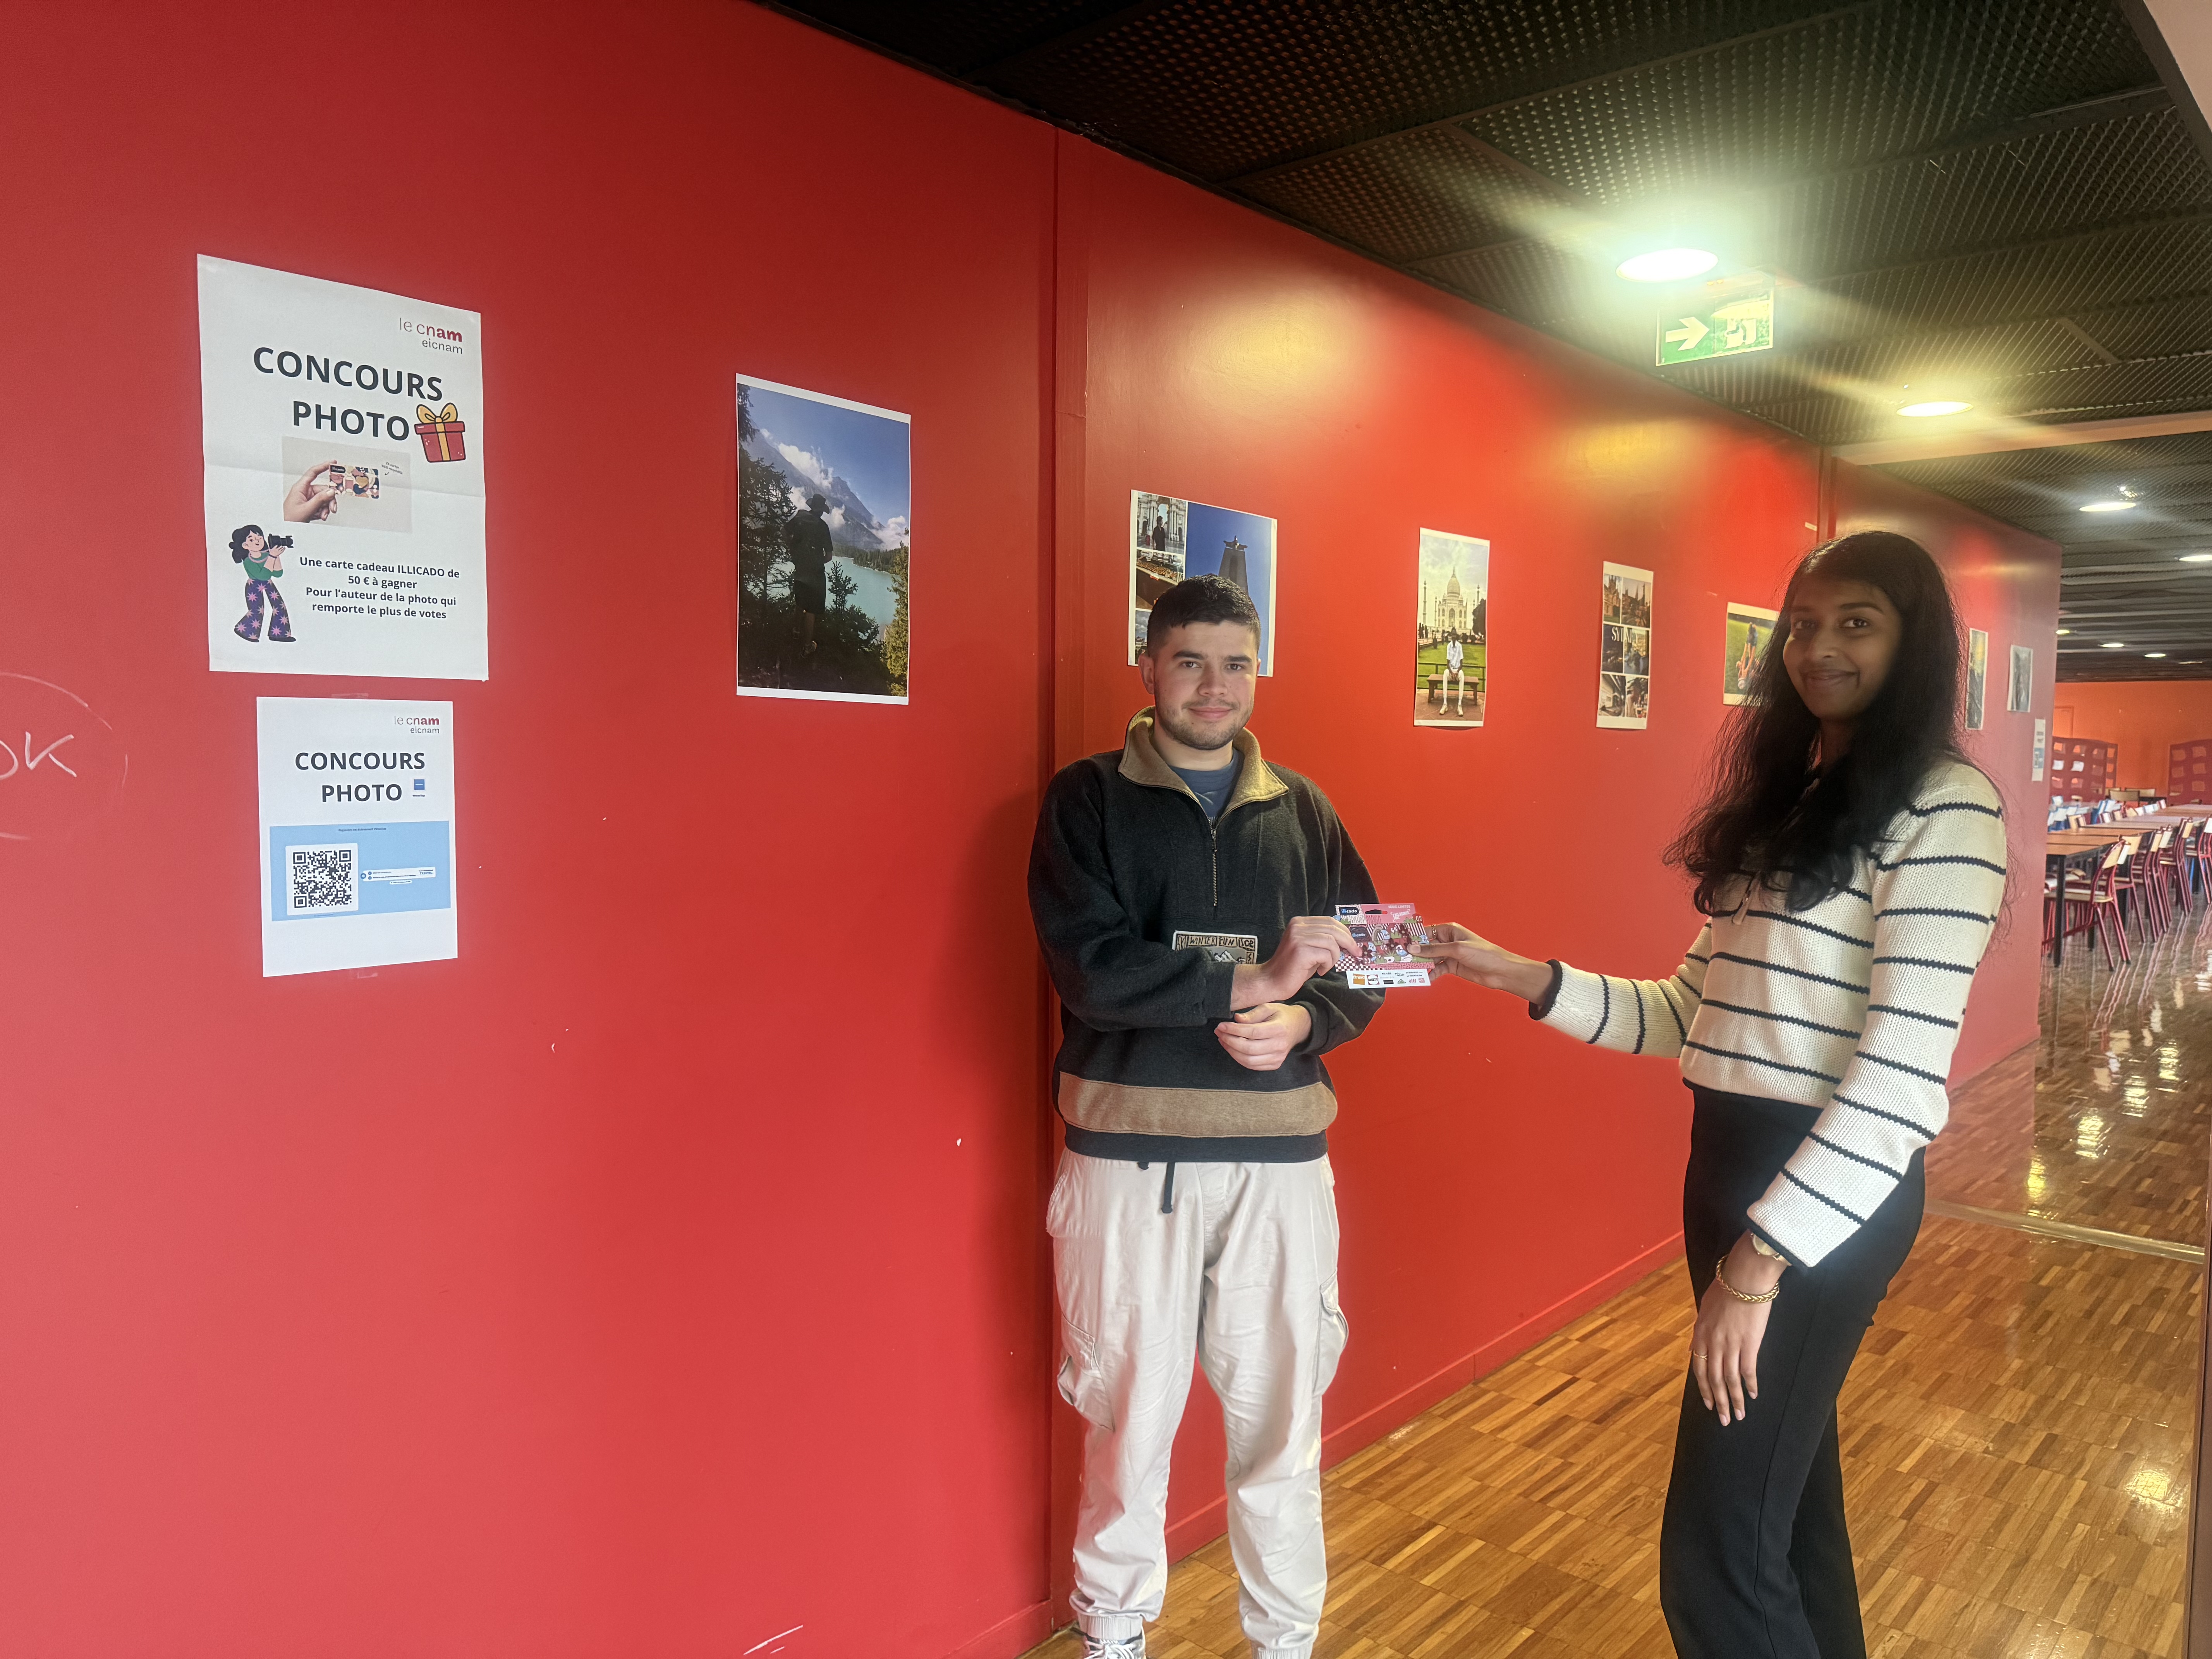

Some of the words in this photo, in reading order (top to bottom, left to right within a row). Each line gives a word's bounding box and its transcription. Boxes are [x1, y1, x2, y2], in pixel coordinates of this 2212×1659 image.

[399, 317, 412, 332] le
[416, 324, 463, 343] cnam
[422, 338, 463, 354] eicnam
[253, 347, 442, 401] CONCOURS
[293, 400, 410, 441] PHOTO
[300, 556, 322, 567] Une
[325, 561, 354, 570] carte
[356, 562, 395, 573] cadeau
[398, 565, 445, 577] ILLICADO
[448, 569, 460, 578] de
[348, 575, 361, 584] 50
[363, 577, 370, 586] €
[372, 576, 378, 586] à
[381, 579, 417, 590] gagner
[306, 587, 332, 597] Pour
[380, 592, 393, 601] de
[396, 592, 405, 602] la
[408, 594, 438, 605] photo
[440, 597, 456, 608] qui
[312, 604, 364, 615] remporte
[367, 605, 377, 615] le
[380, 606, 401, 617] plus
[404, 608, 417, 617] de
[419, 610, 447, 619] votes
[394, 715, 404, 725] le
[406, 717, 440, 725] cnam
[295, 752, 425, 770] CONCOURS
[322, 784, 402, 802] PHOTO
[1190, 936, 1216, 945] WINTER
[1219, 937, 1235, 945] FUN
